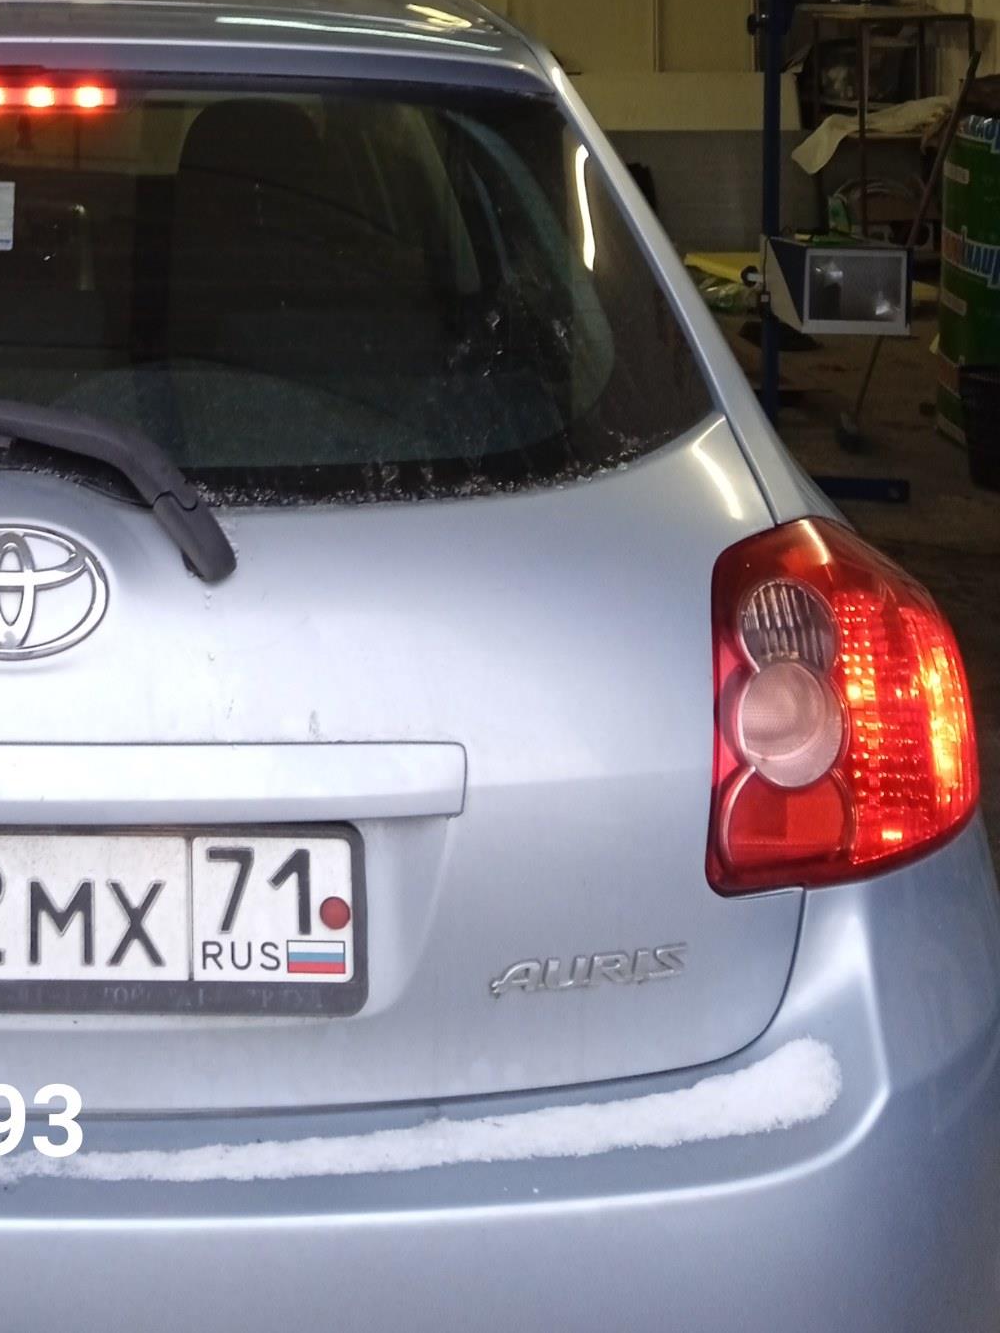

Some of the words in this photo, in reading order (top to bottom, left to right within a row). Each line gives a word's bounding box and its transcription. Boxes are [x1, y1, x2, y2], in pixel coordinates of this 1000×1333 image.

[205, 847, 312, 936] 71
[202, 940, 281, 971] RUS
[490, 942, 687, 997] AURIS
